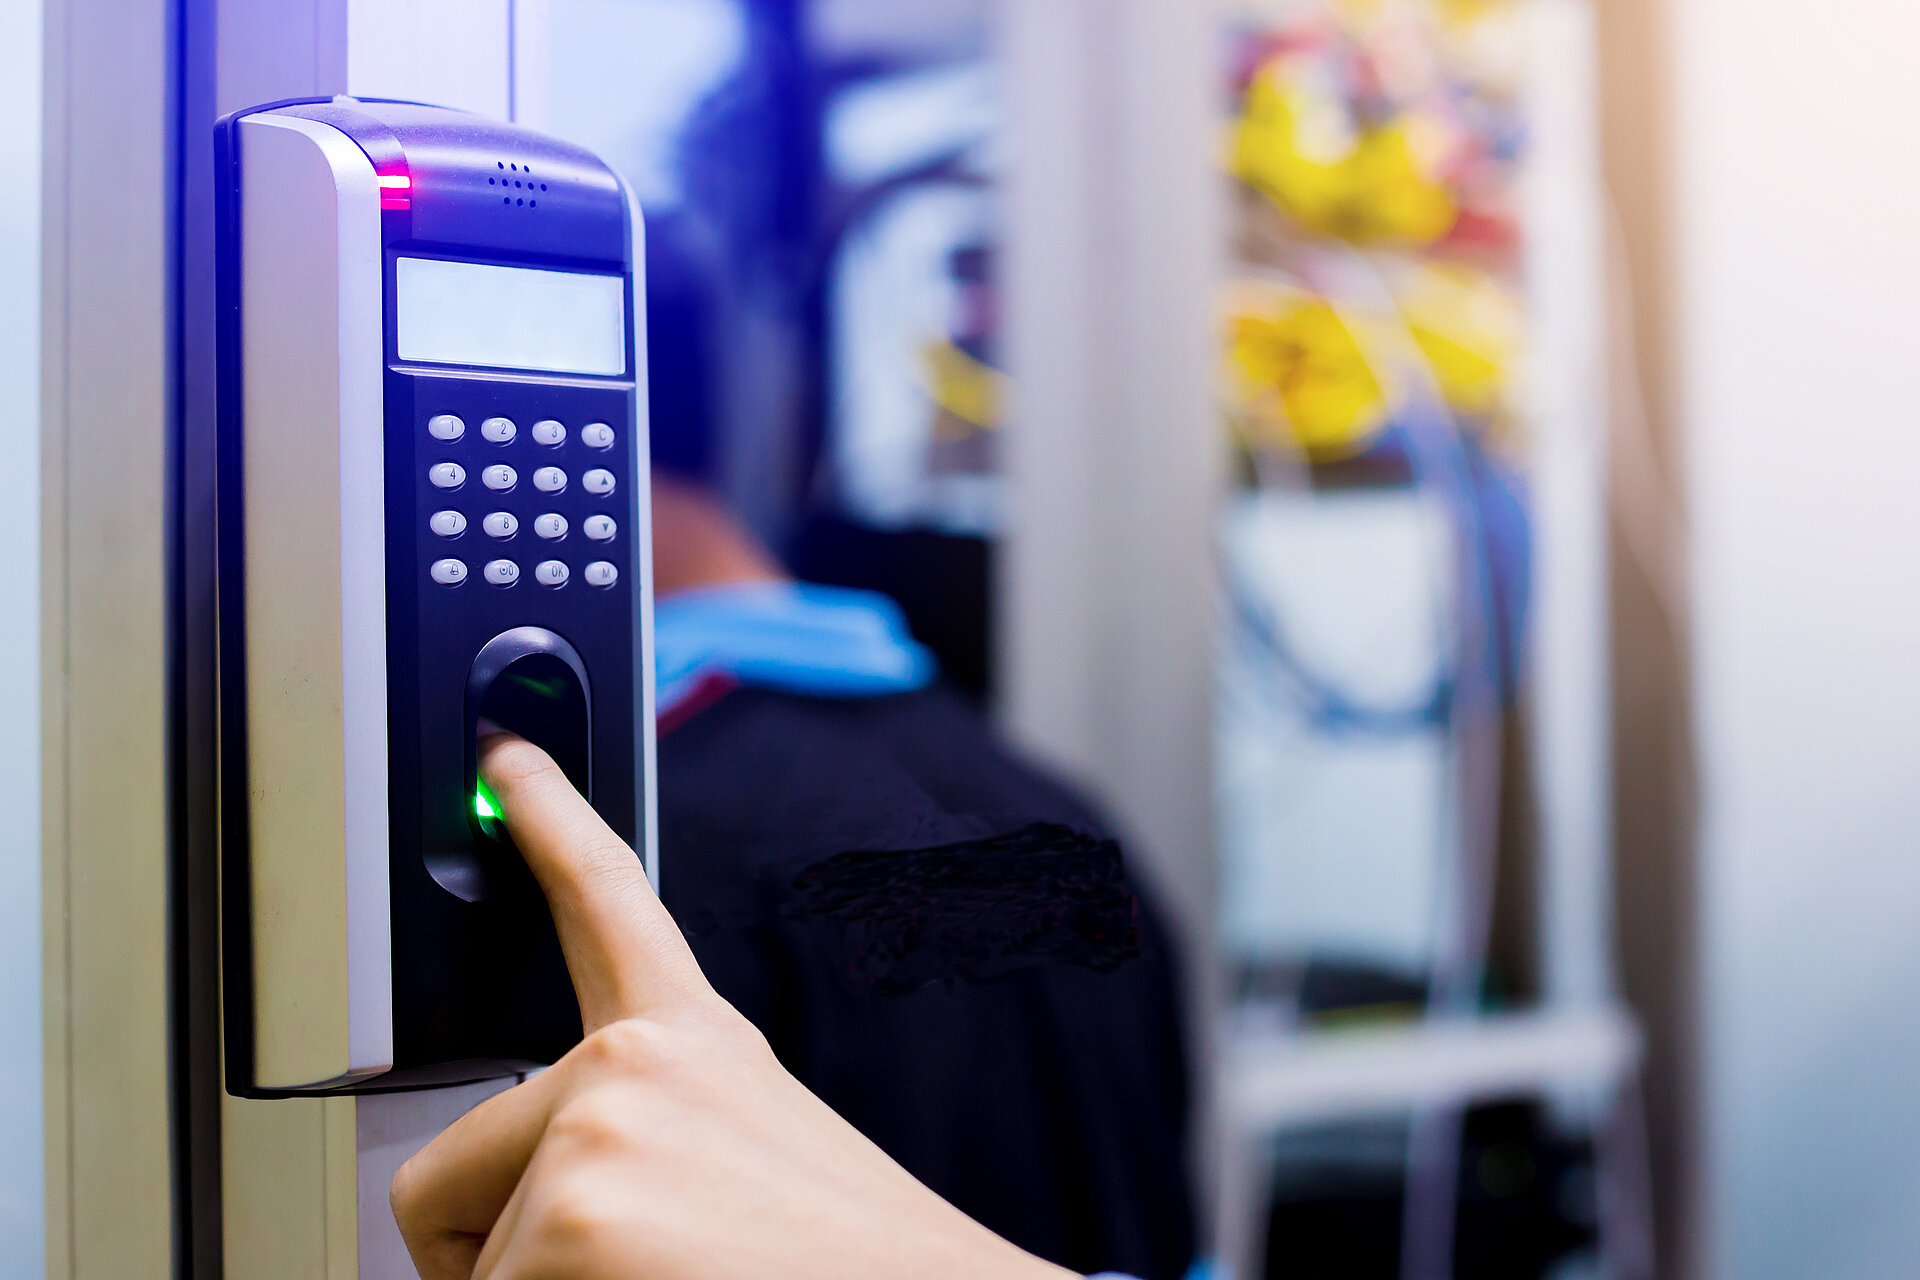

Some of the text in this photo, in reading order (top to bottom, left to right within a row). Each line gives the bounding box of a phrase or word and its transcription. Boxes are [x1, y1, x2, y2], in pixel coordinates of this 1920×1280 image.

[449, 420, 607, 441] 1 2 3 C
[449, 468, 559, 485] 4 5 6
[450, 515, 560, 531] 7 8 9
[551, 565, 564, 578] OK
[602, 567, 611, 579] M
